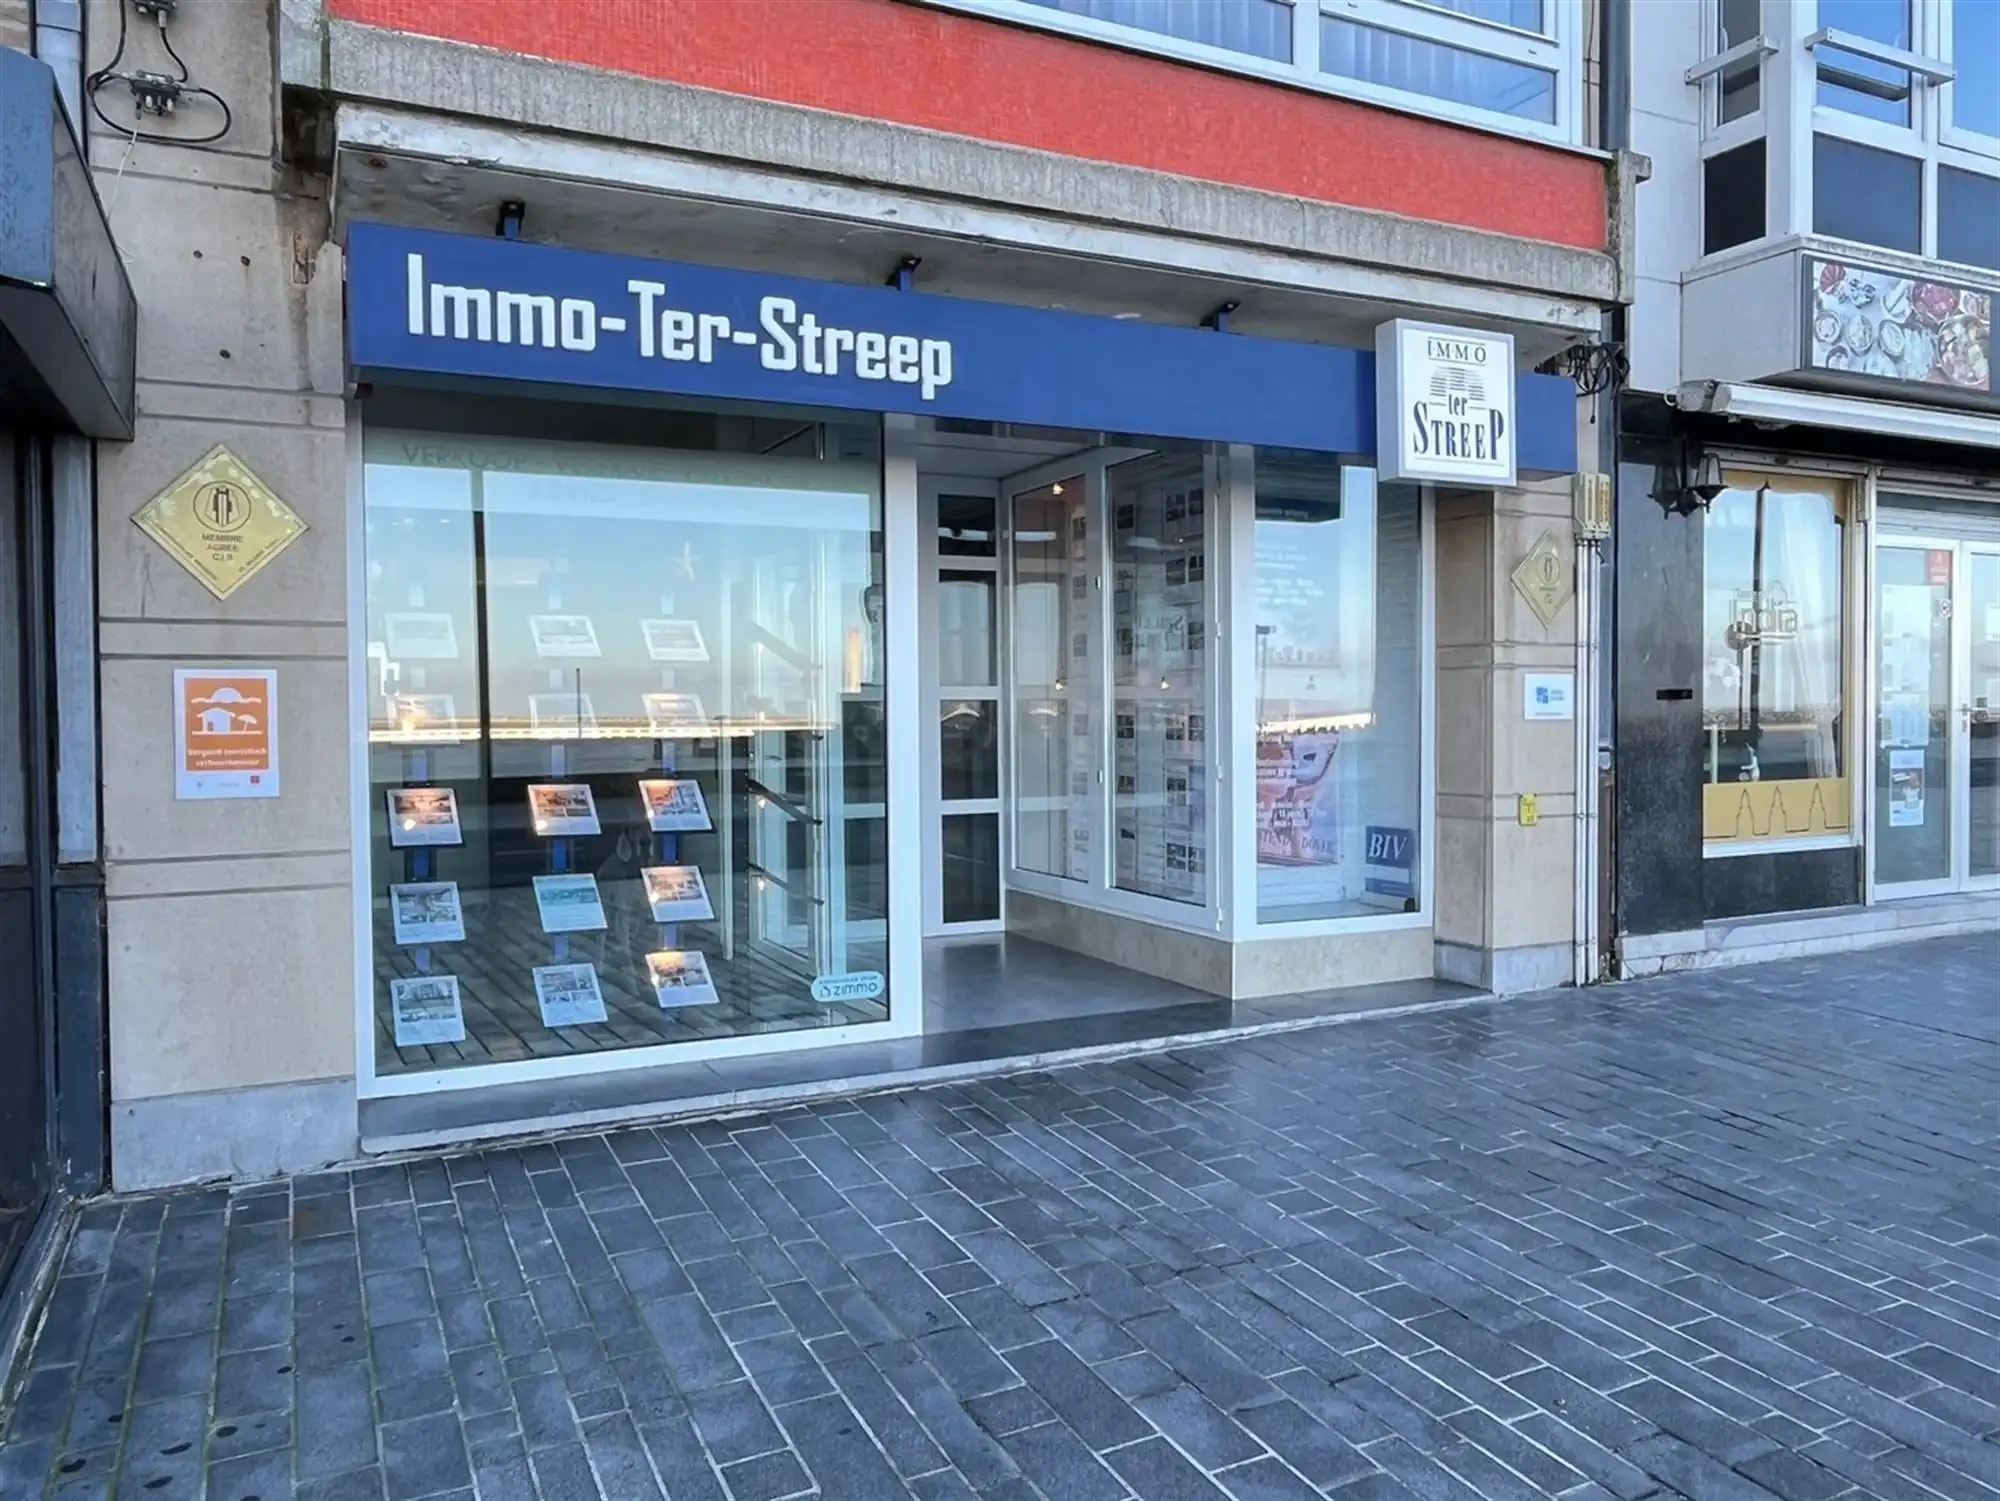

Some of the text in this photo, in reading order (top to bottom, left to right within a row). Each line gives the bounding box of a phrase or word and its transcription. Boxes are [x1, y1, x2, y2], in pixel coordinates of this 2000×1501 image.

[407, 253, 953, 400] Immo-Ter-Streep
[1427, 339, 1487, 364] IMMO
[1448, 393, 1468, 417] ter
[1413, 400, 1505, 461] STREEP
[1368, 833, 1408, 860] BIV
